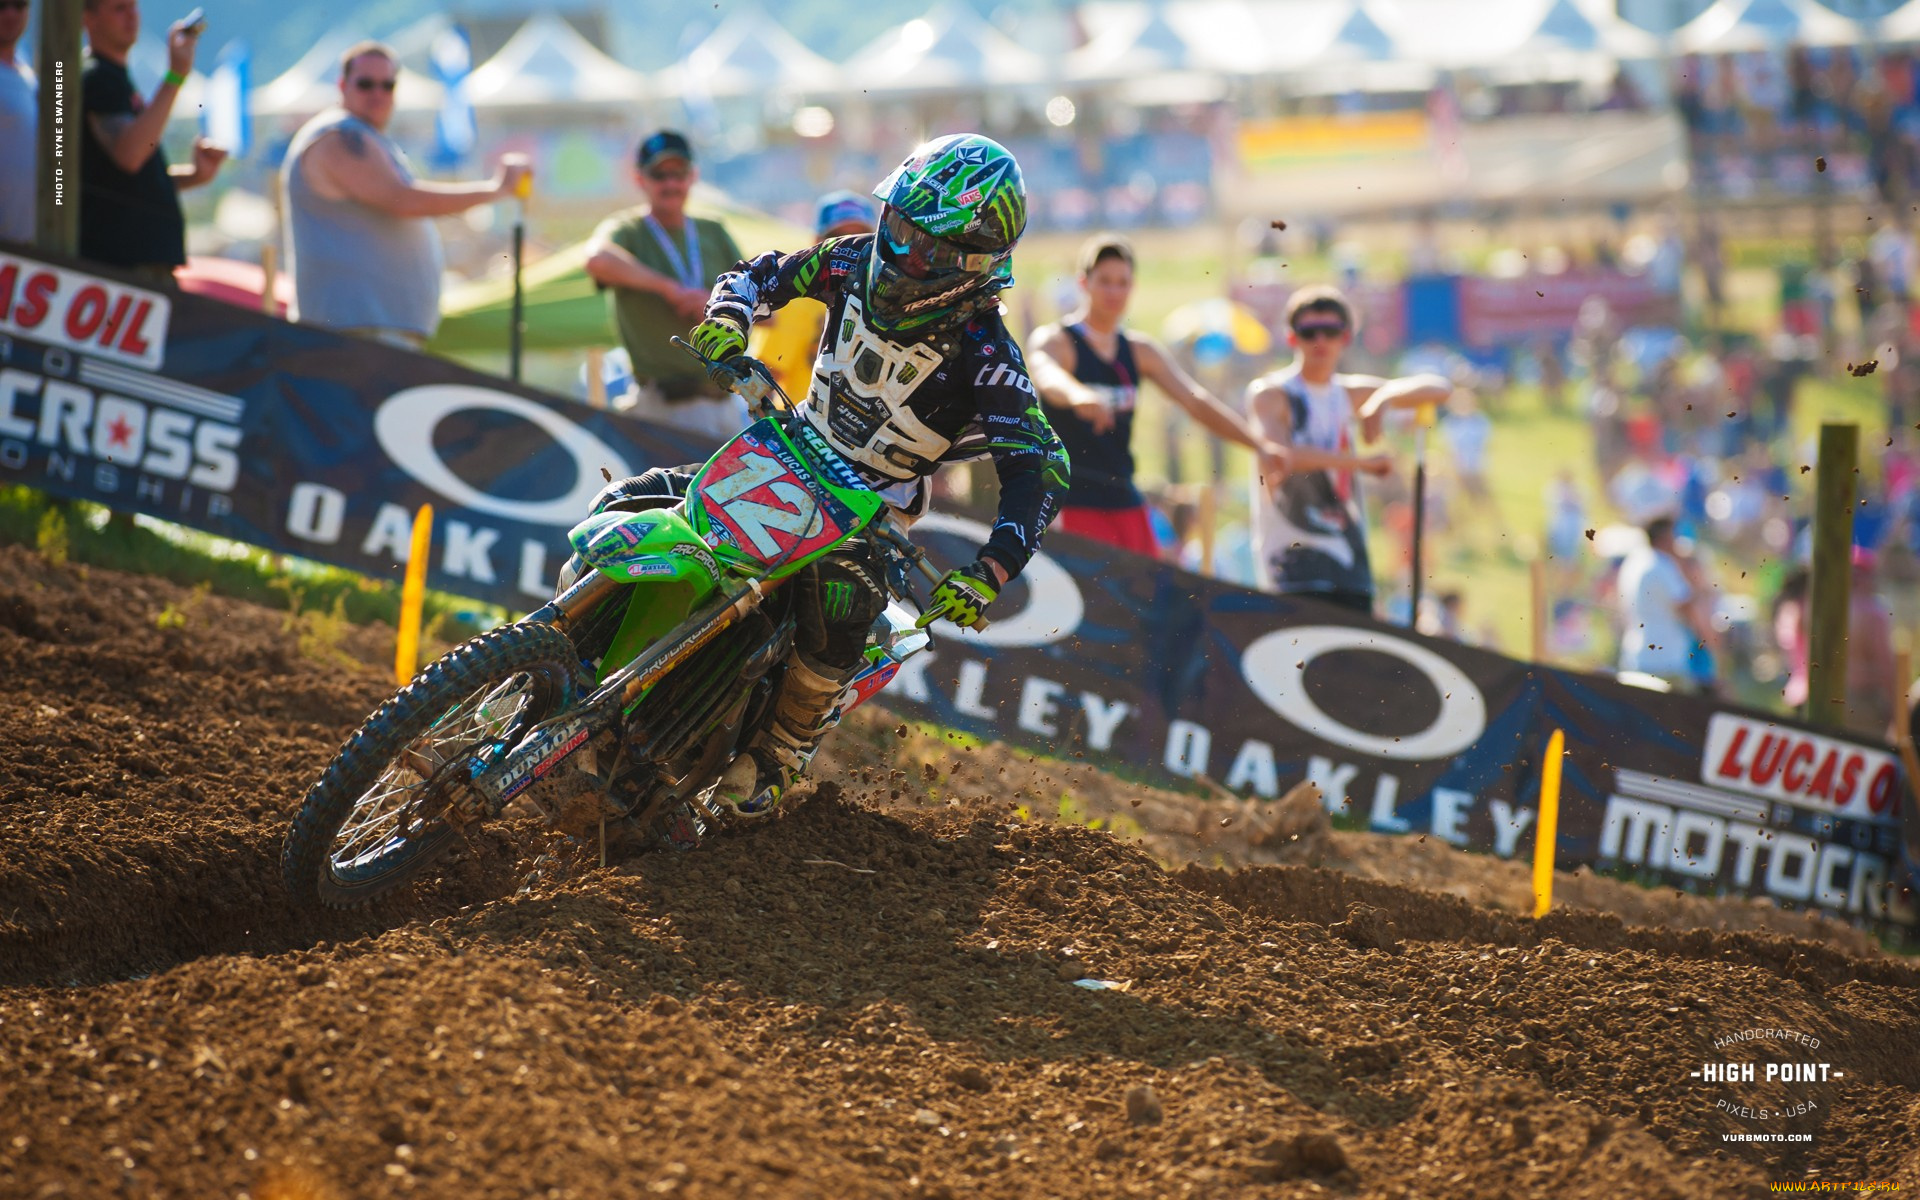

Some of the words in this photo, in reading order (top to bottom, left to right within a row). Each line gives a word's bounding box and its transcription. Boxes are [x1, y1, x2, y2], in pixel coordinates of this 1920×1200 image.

[955, 188, 982, 206] VANS
[64, 283, 154, 357] OIL
[0, 366, 243, 492] CROSS
[987, 414, 1021, 425] SHOWA
[777, 451, 811, 481] LUCAS
[802, 425, 872, 492] RENTHA
[286, 481, 558, 599] OAKL
[703, 451, 825, 560] 12
[670, 543, 698, 557] PRO
[695, 549, 721, 584] CIRCUIT
[839, 559, 883, 599] thor
[880, 649, 1130, 751] KLEY
[498, 718, 582, 790] DUNLOP
[533, 727, 590, 778] BRAKING
[1163, 717, 1536, 859] OAKLEY
[1718, 725, 1865, 807] LUCAS
